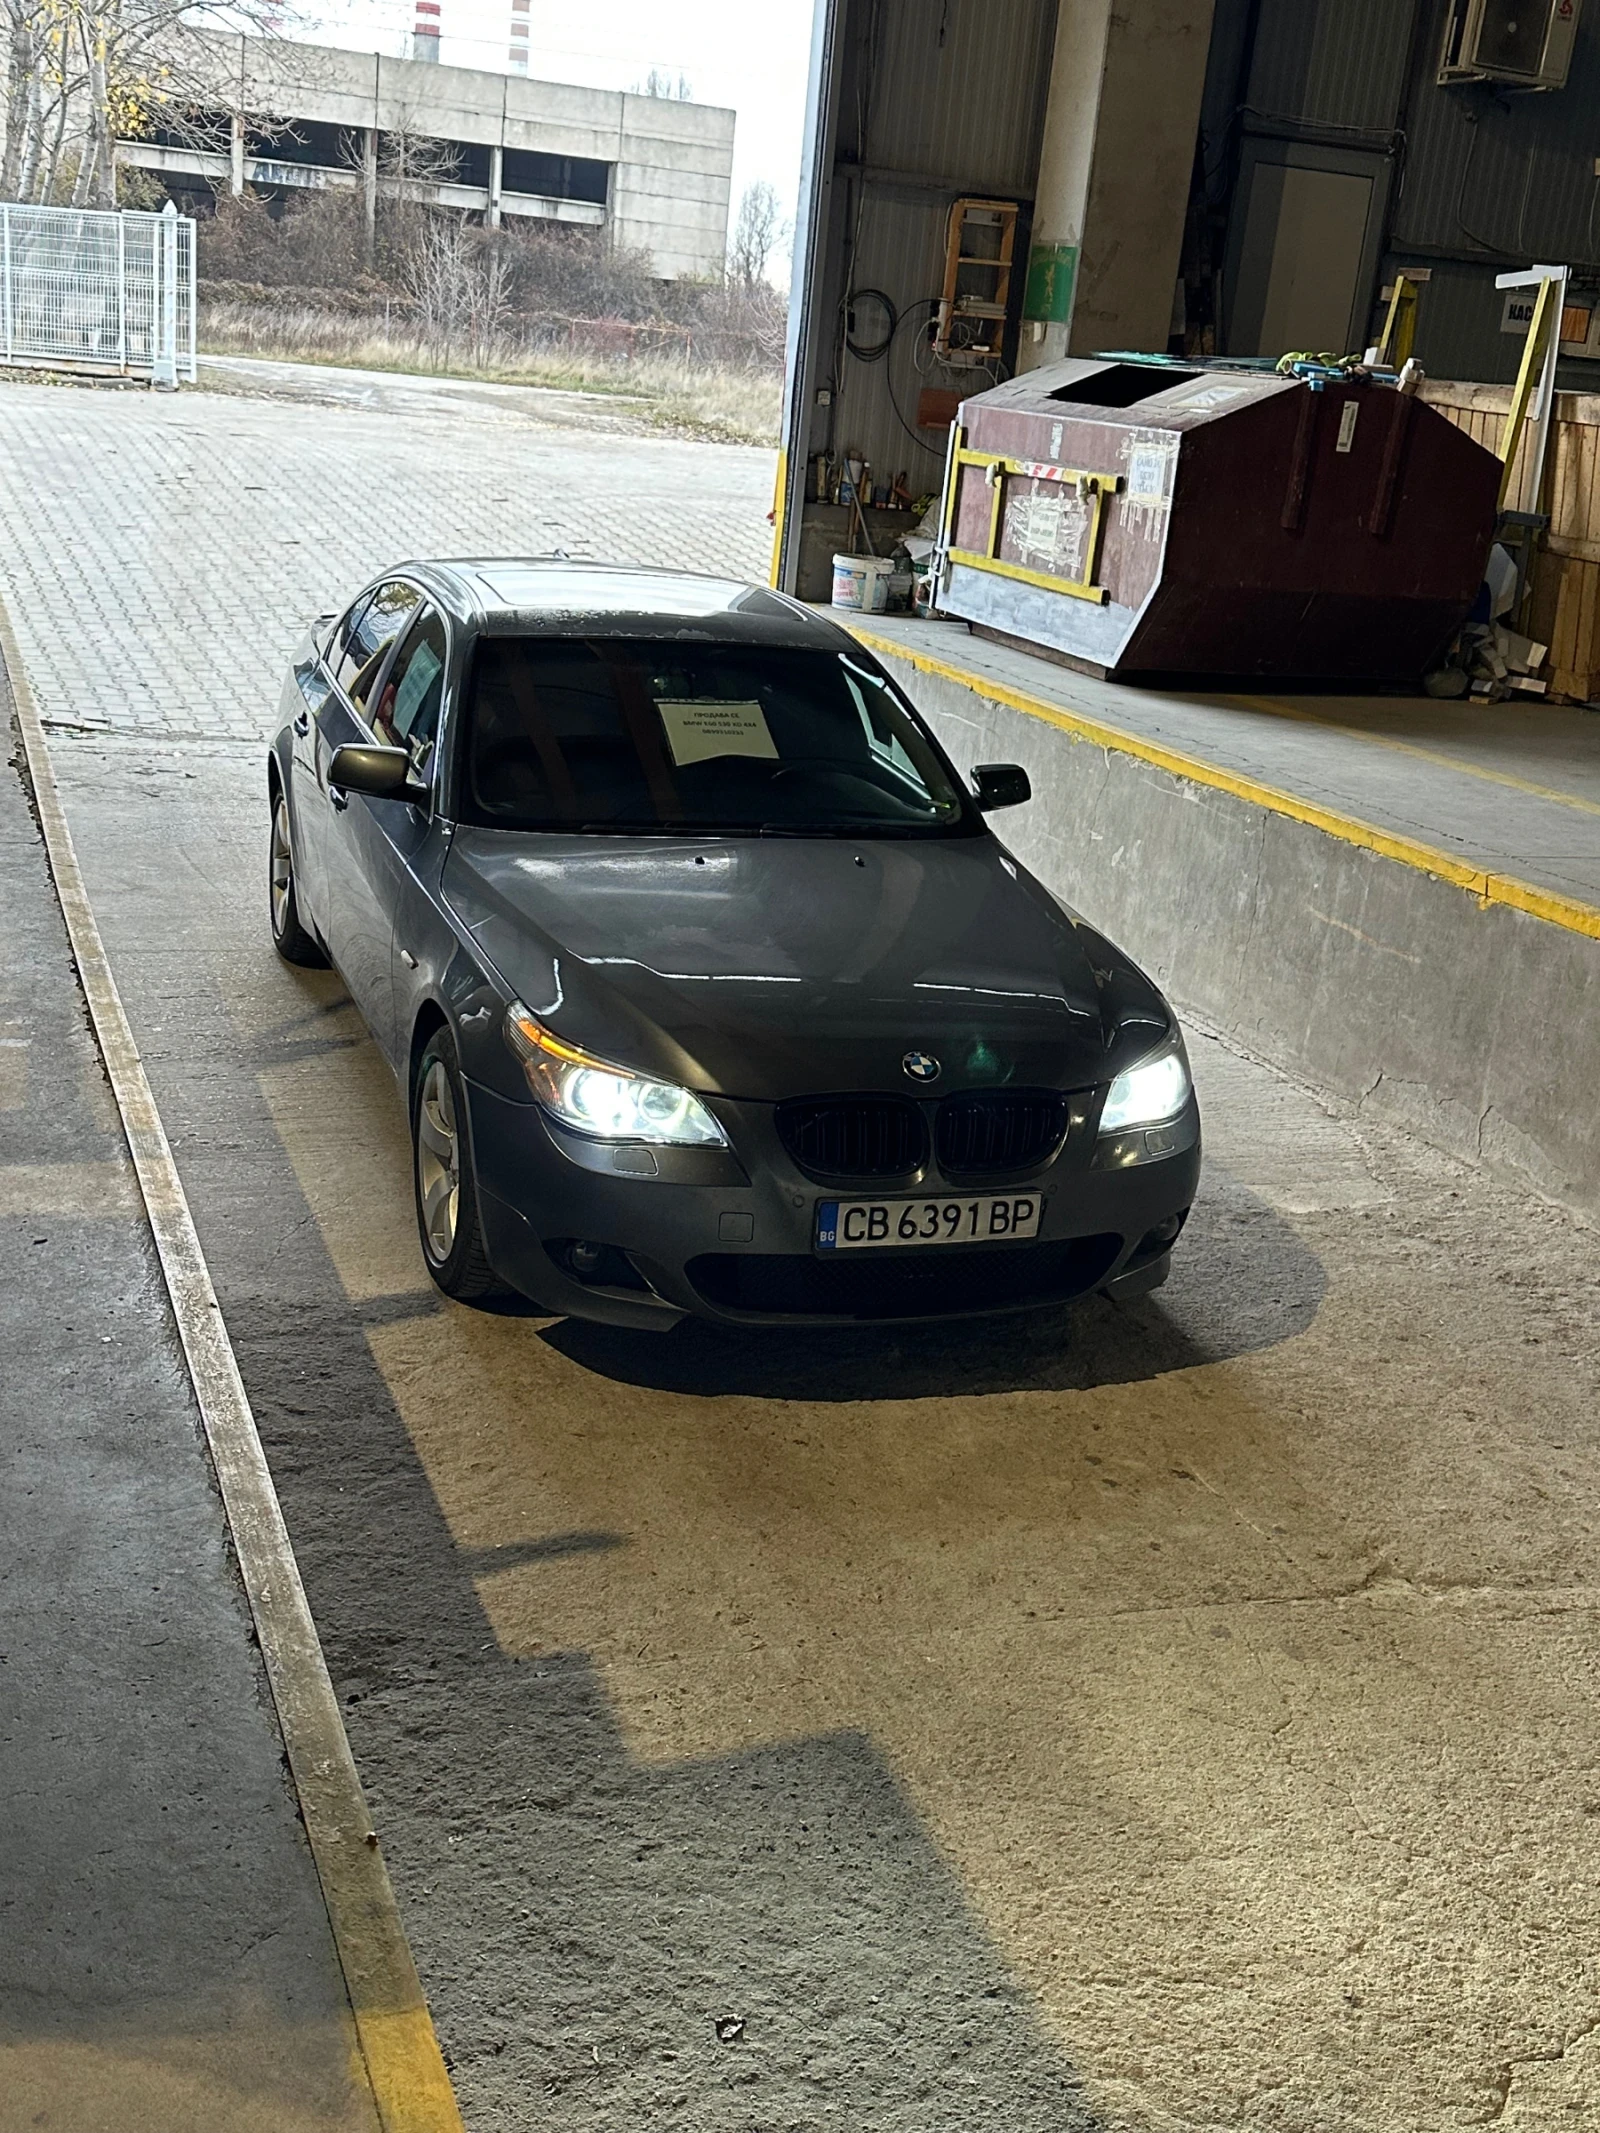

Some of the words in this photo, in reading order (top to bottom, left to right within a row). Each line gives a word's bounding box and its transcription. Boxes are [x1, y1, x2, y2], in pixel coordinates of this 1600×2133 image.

[1508, 304, 1532, 321] КАС
[843, 1206, 889, 1241] CB
[897, 1202, 979, 1239] 6391
[989, 1199, 1034, 1235] BP
[819, 1231, 835, 1242] BG
